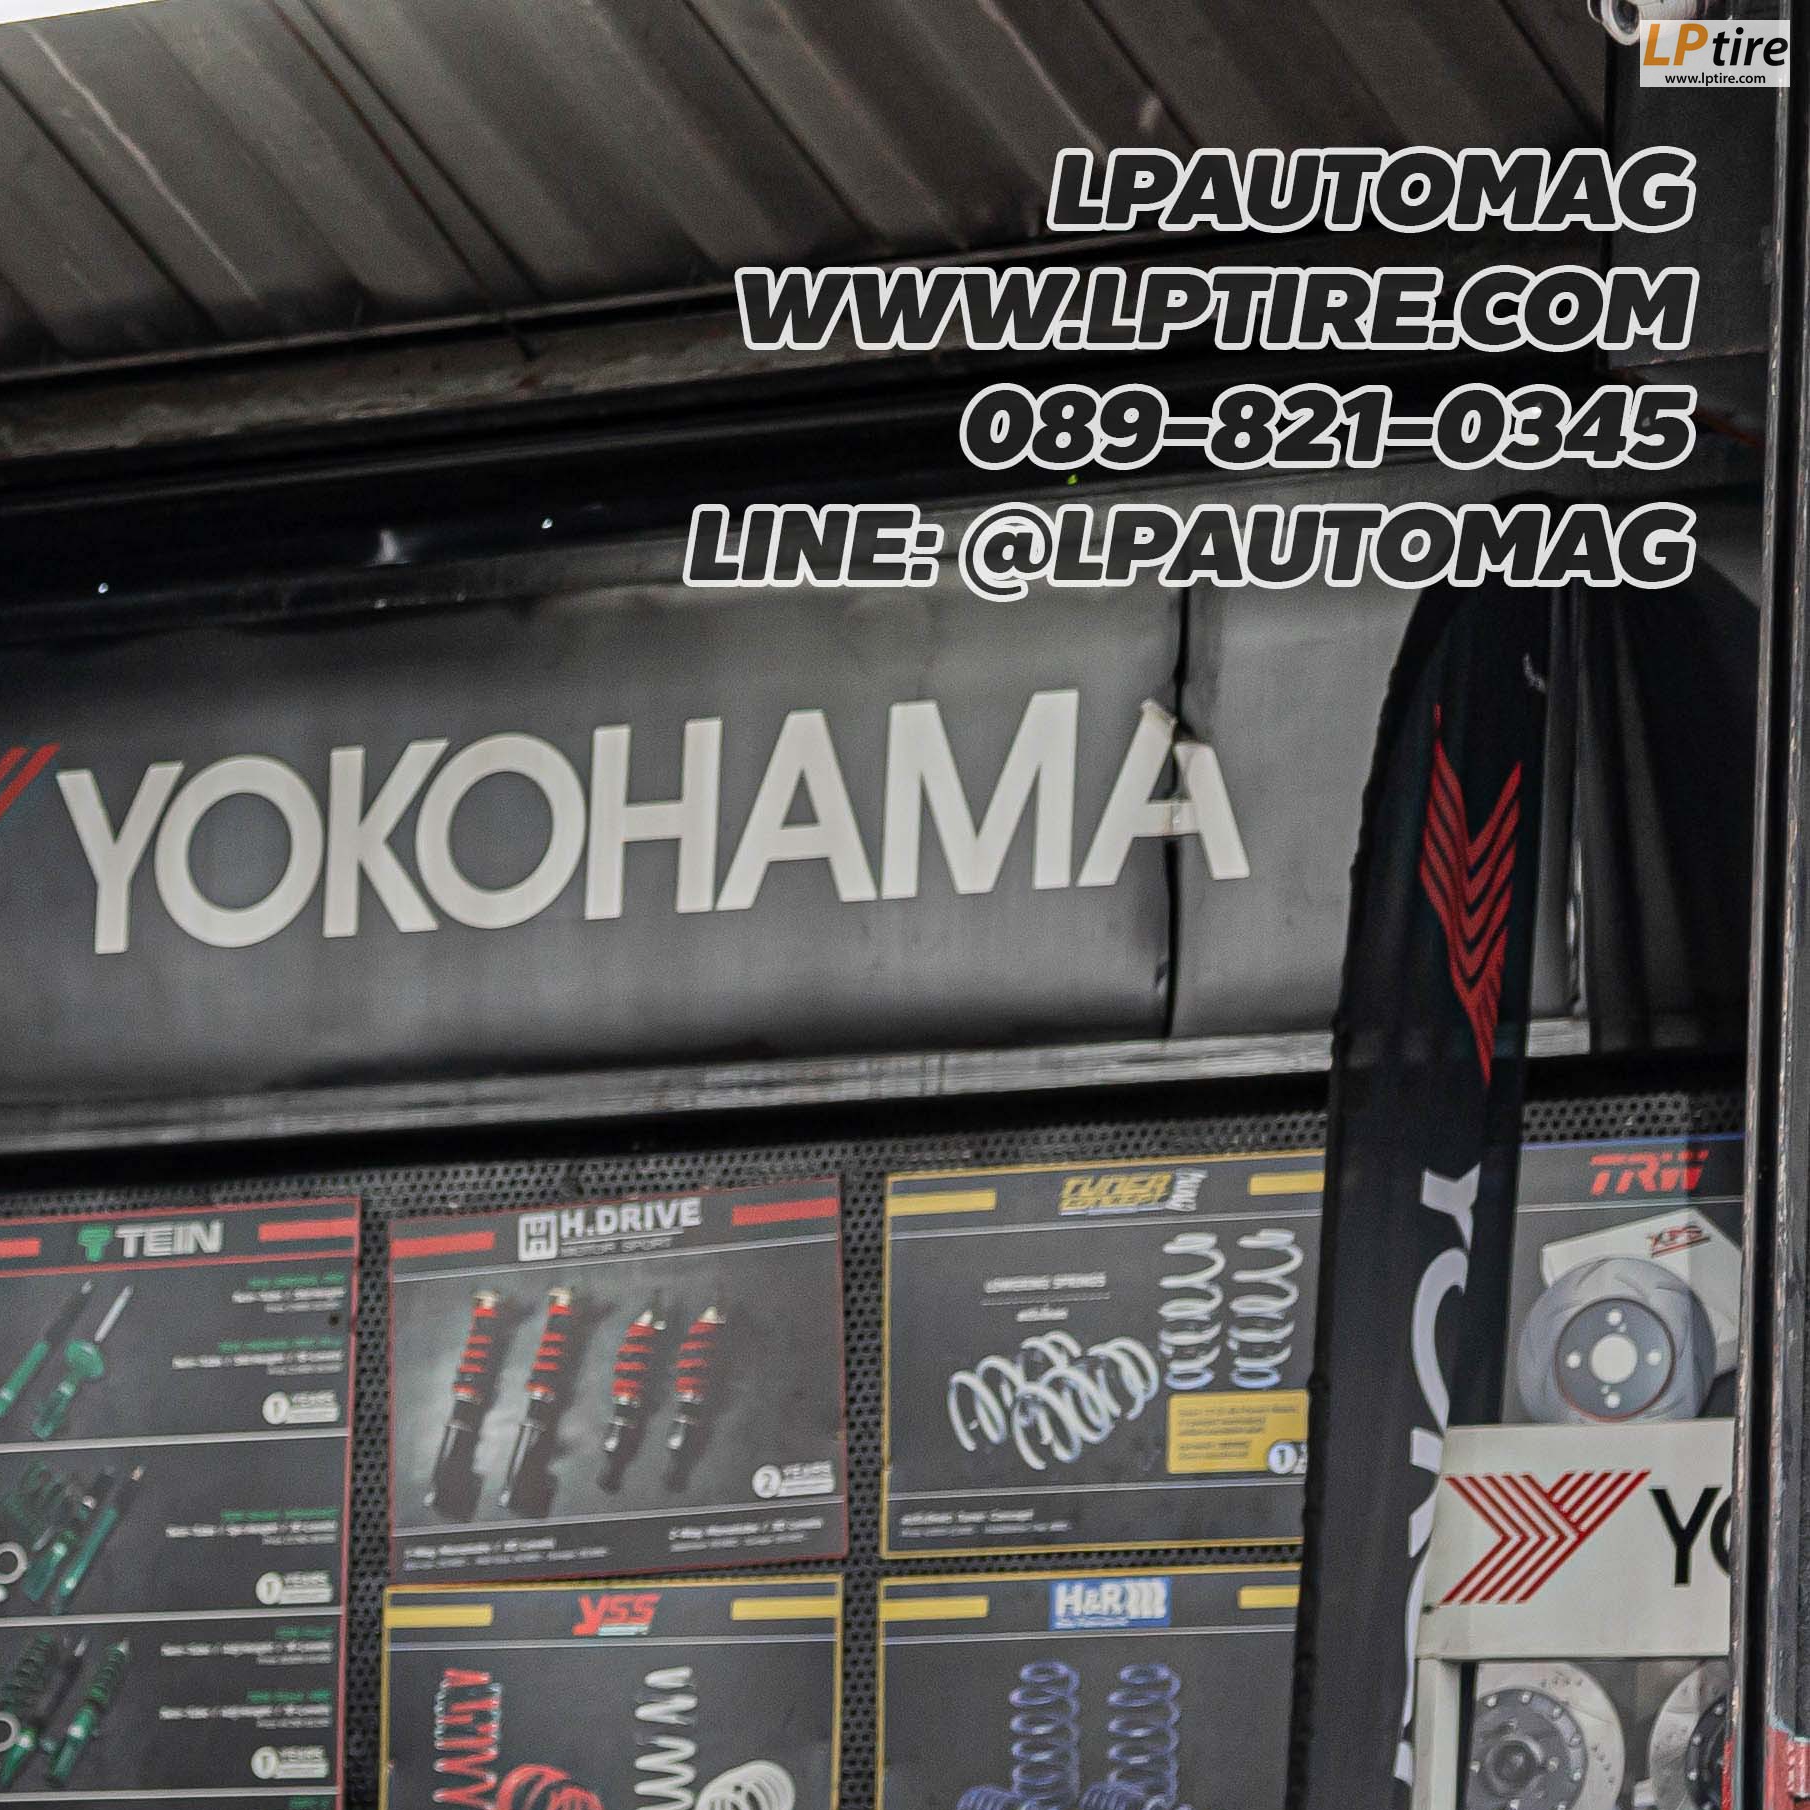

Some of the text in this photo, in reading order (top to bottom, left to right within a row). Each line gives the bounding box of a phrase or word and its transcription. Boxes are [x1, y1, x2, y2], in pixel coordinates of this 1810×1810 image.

[55, 689, 1249, 955] YOKOHAMA
[1591, 1150, 1708, 1195] TRW
[114, 1220, 224, 1258] TEIN
[560, 1197, 701, 1238] H.DRIVE
